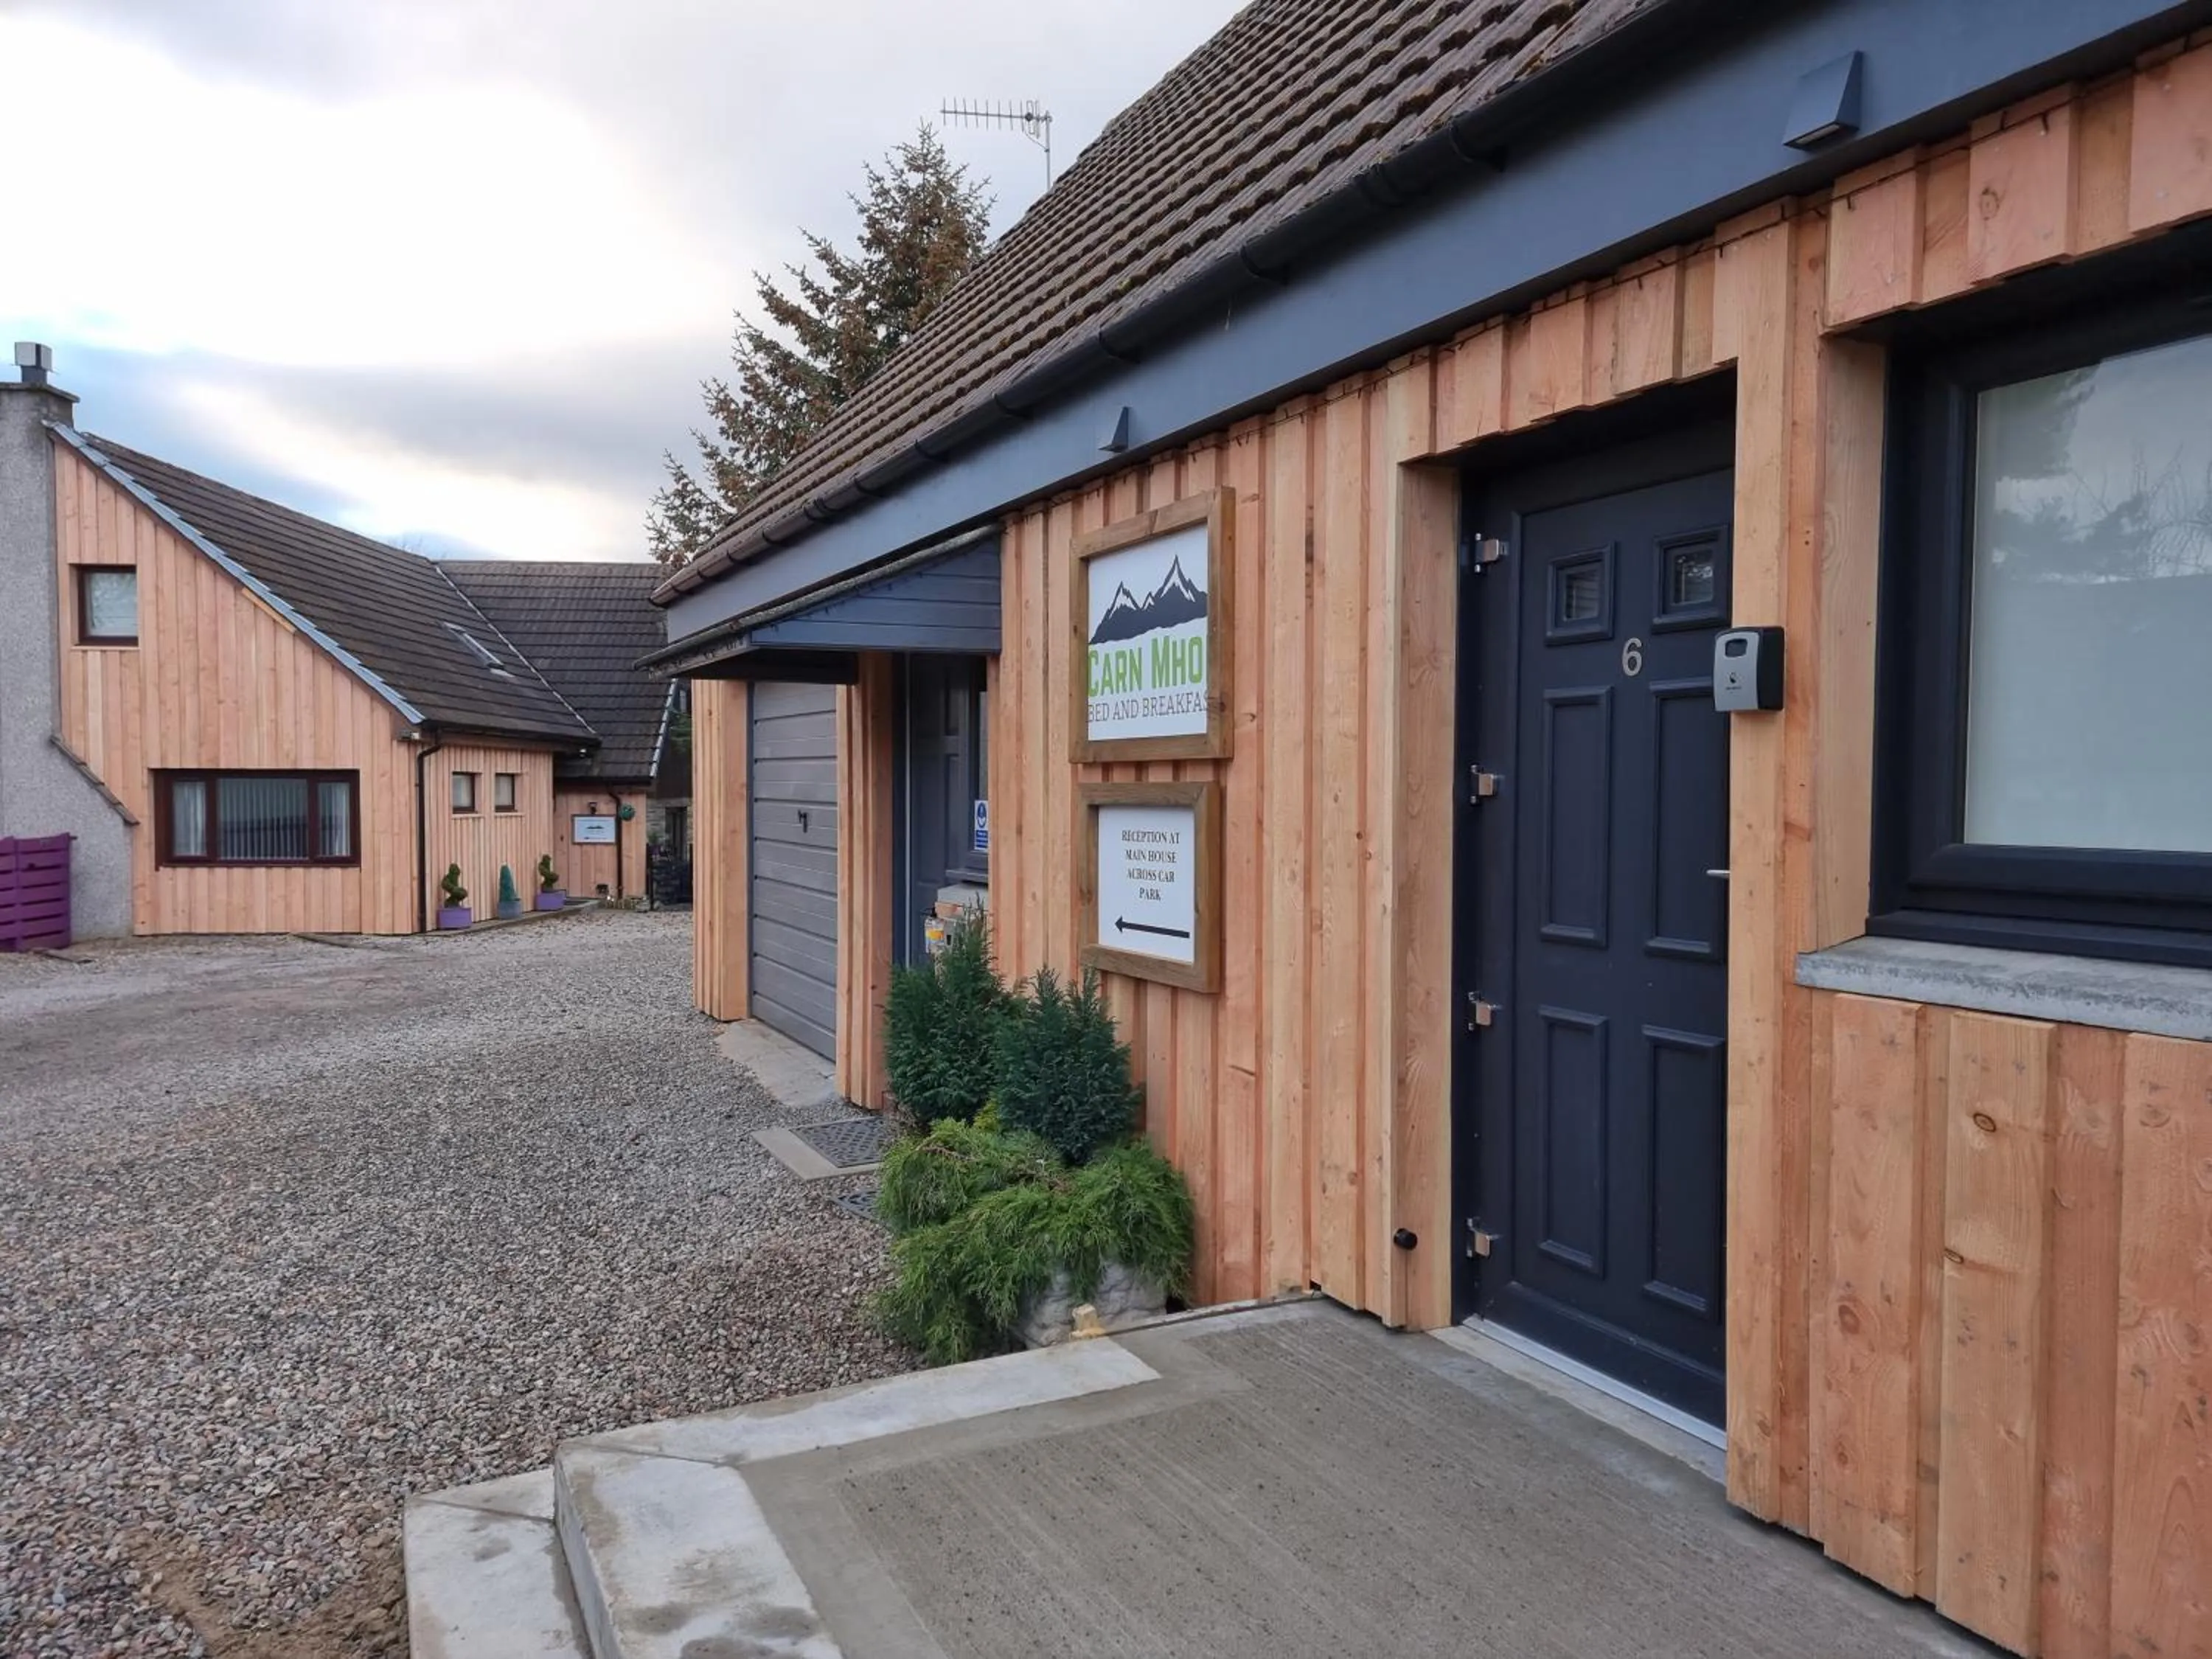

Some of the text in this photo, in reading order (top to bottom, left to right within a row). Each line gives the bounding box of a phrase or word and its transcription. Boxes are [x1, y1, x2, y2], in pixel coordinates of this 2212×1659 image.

[1622, 637, 1643, 676] 6
[1088, 635, 1203, 697] CARN MHO
[1088, 703, 1110, 723] BED
[1113, 698, 1139, 720] AND
[1121, 830, 1180, 844] RECEPTION AT
[1125, 849, 1177, 863] MAIN HOUSE
[1127, 868, 1175, 883] ACROSS CAR
[1138, 887, 1161, 901] PARK
